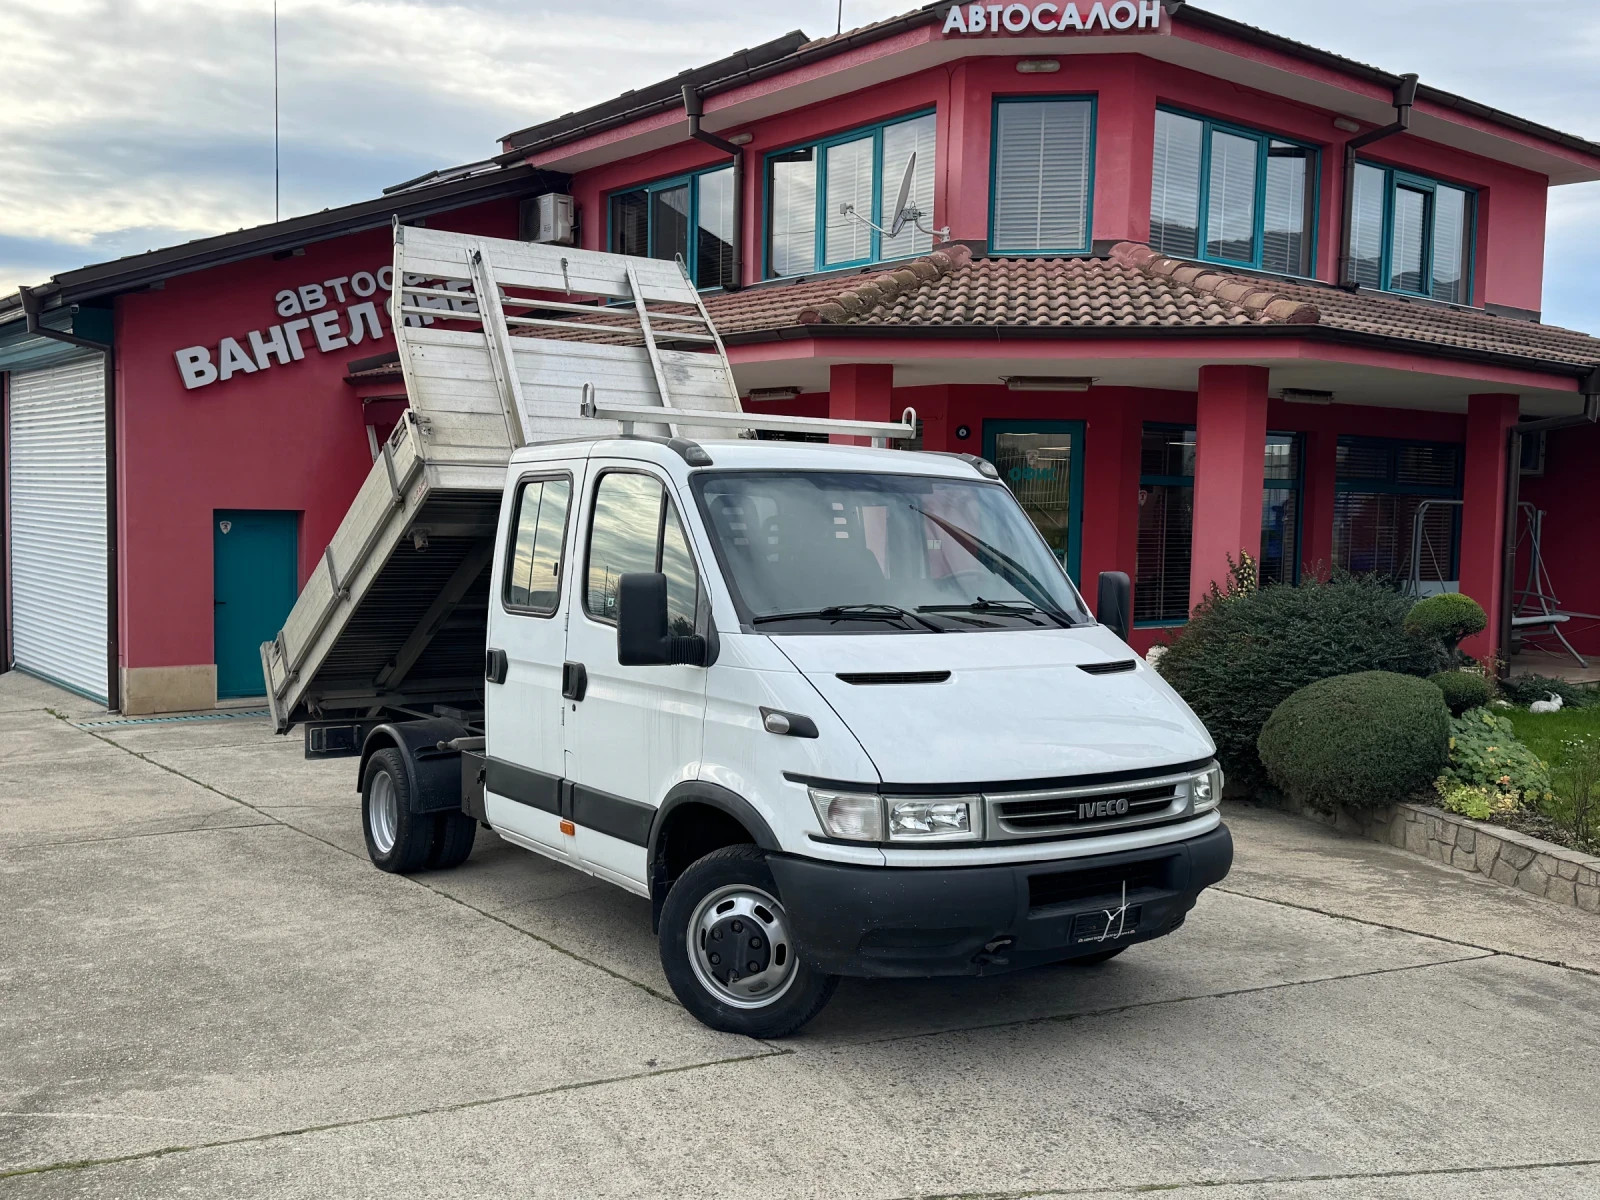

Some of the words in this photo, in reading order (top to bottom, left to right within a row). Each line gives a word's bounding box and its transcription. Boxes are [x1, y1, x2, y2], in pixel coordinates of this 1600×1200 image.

[942, 0, 1161, 34] АВТОСАЛОН
[174, 301, 384, 390] ВАНГЕЛ
[1078, 798, 1129, 820] IVECO
